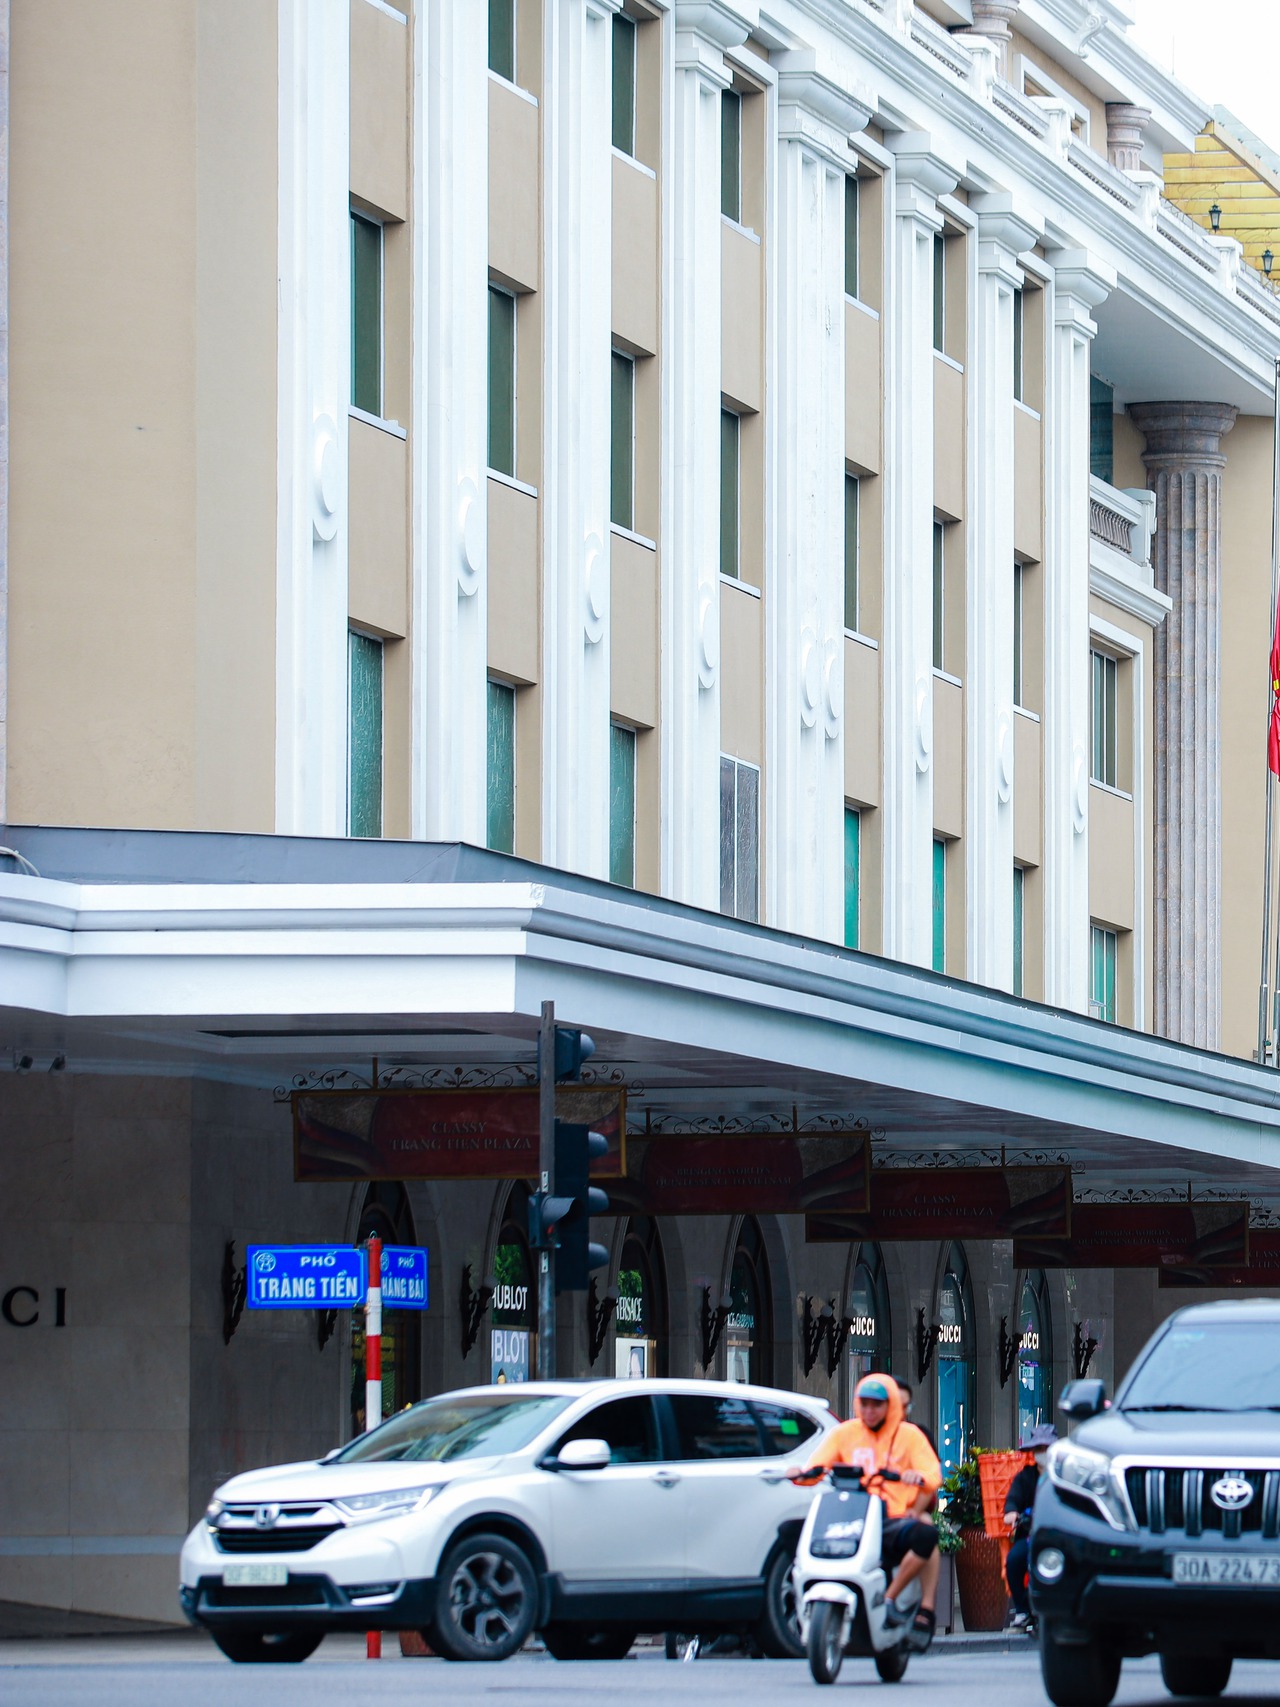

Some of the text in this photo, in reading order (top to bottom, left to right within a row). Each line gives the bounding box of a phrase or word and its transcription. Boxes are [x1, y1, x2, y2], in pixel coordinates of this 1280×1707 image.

[431, 1120, 487, 1135] CLASSY
[390, 1137, 532, 1151] TRANG TIEN PLAZA
[733, 1177, 745, 1186] TO
[747, 1176, 792, 1185] VIETNAM
[914, 1194, 958, 1204] CLASSY
[881, 1206, 993, 1218] TRANG TIEN PLAZA
[300, 1250, 337, 1267] PHỐ
[938, 1324, 961, 1343] GUCCI
[492, 1329, 528, 1364] BLOT
